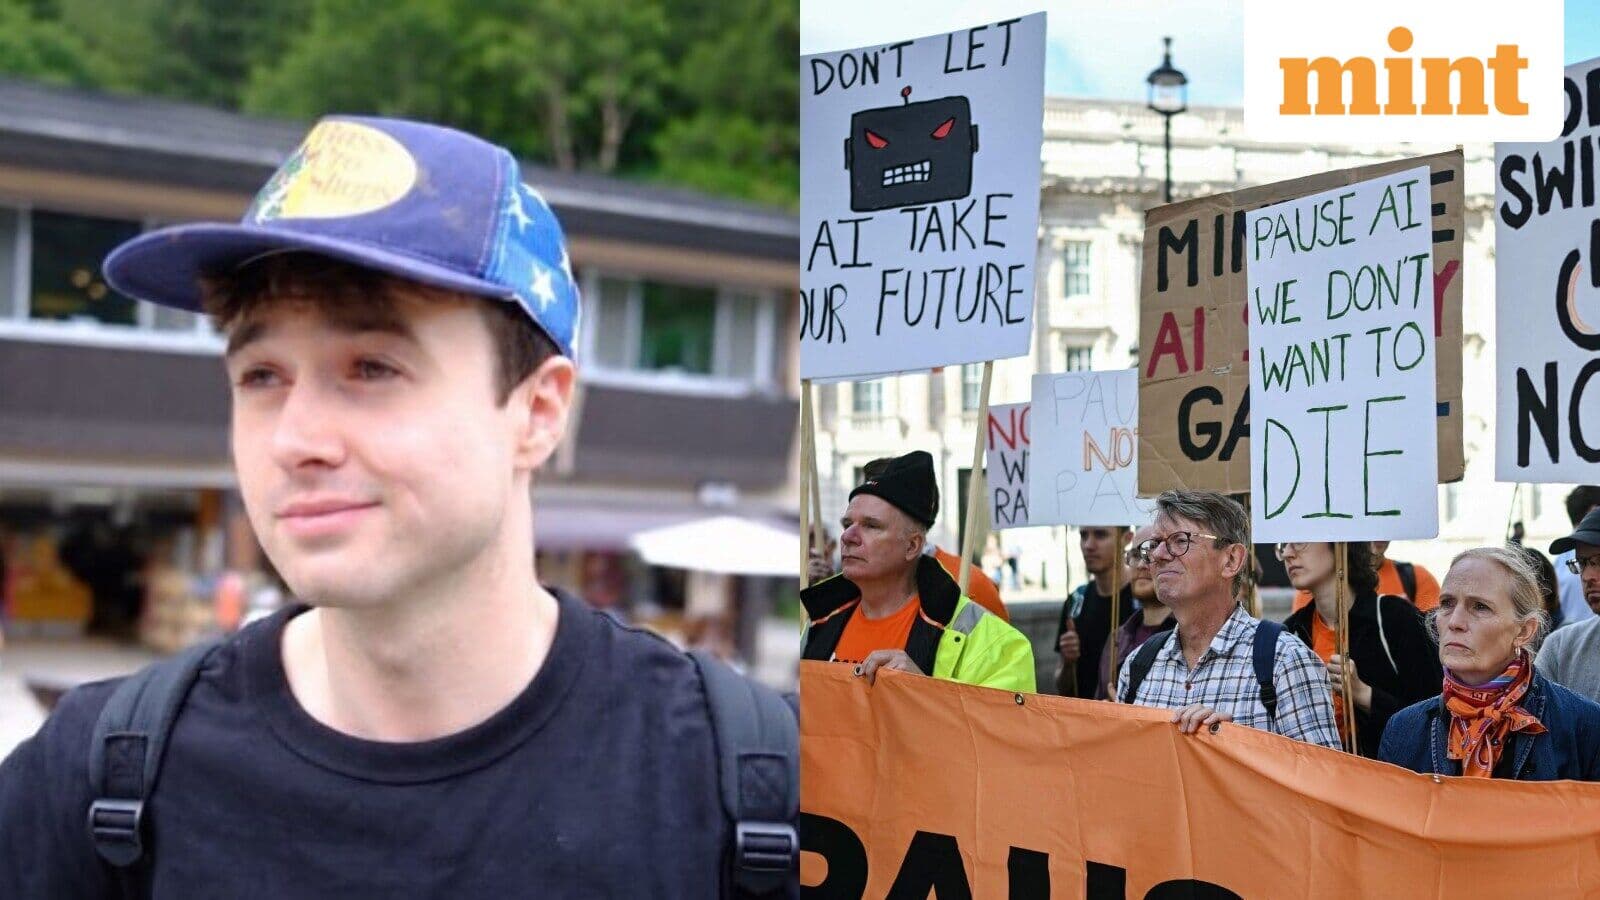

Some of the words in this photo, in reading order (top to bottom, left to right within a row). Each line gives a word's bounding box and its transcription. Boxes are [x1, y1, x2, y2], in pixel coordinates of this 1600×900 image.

[811, 41, 914, 95] DON'T
[944, 18, 1022, 74] LET
[807, 217, 874, 272] AI
[900, 193, 1014, 253] TAKE
[1255, 192, 1357, 261] PAUSE
[1369, 179, 1423, 236] AI
[876, 262, 1026, 336] FUTURE
[1255, 279, 1301, 325] WE
[1327, 253, 1430, 320] DON'T
[1146, 306, 1205, 378] AI
[1260, 333, 1352, 393] WANT
[1366, 322, 1426, 377] TO
[1263, 395, 1406, 520] DIE
